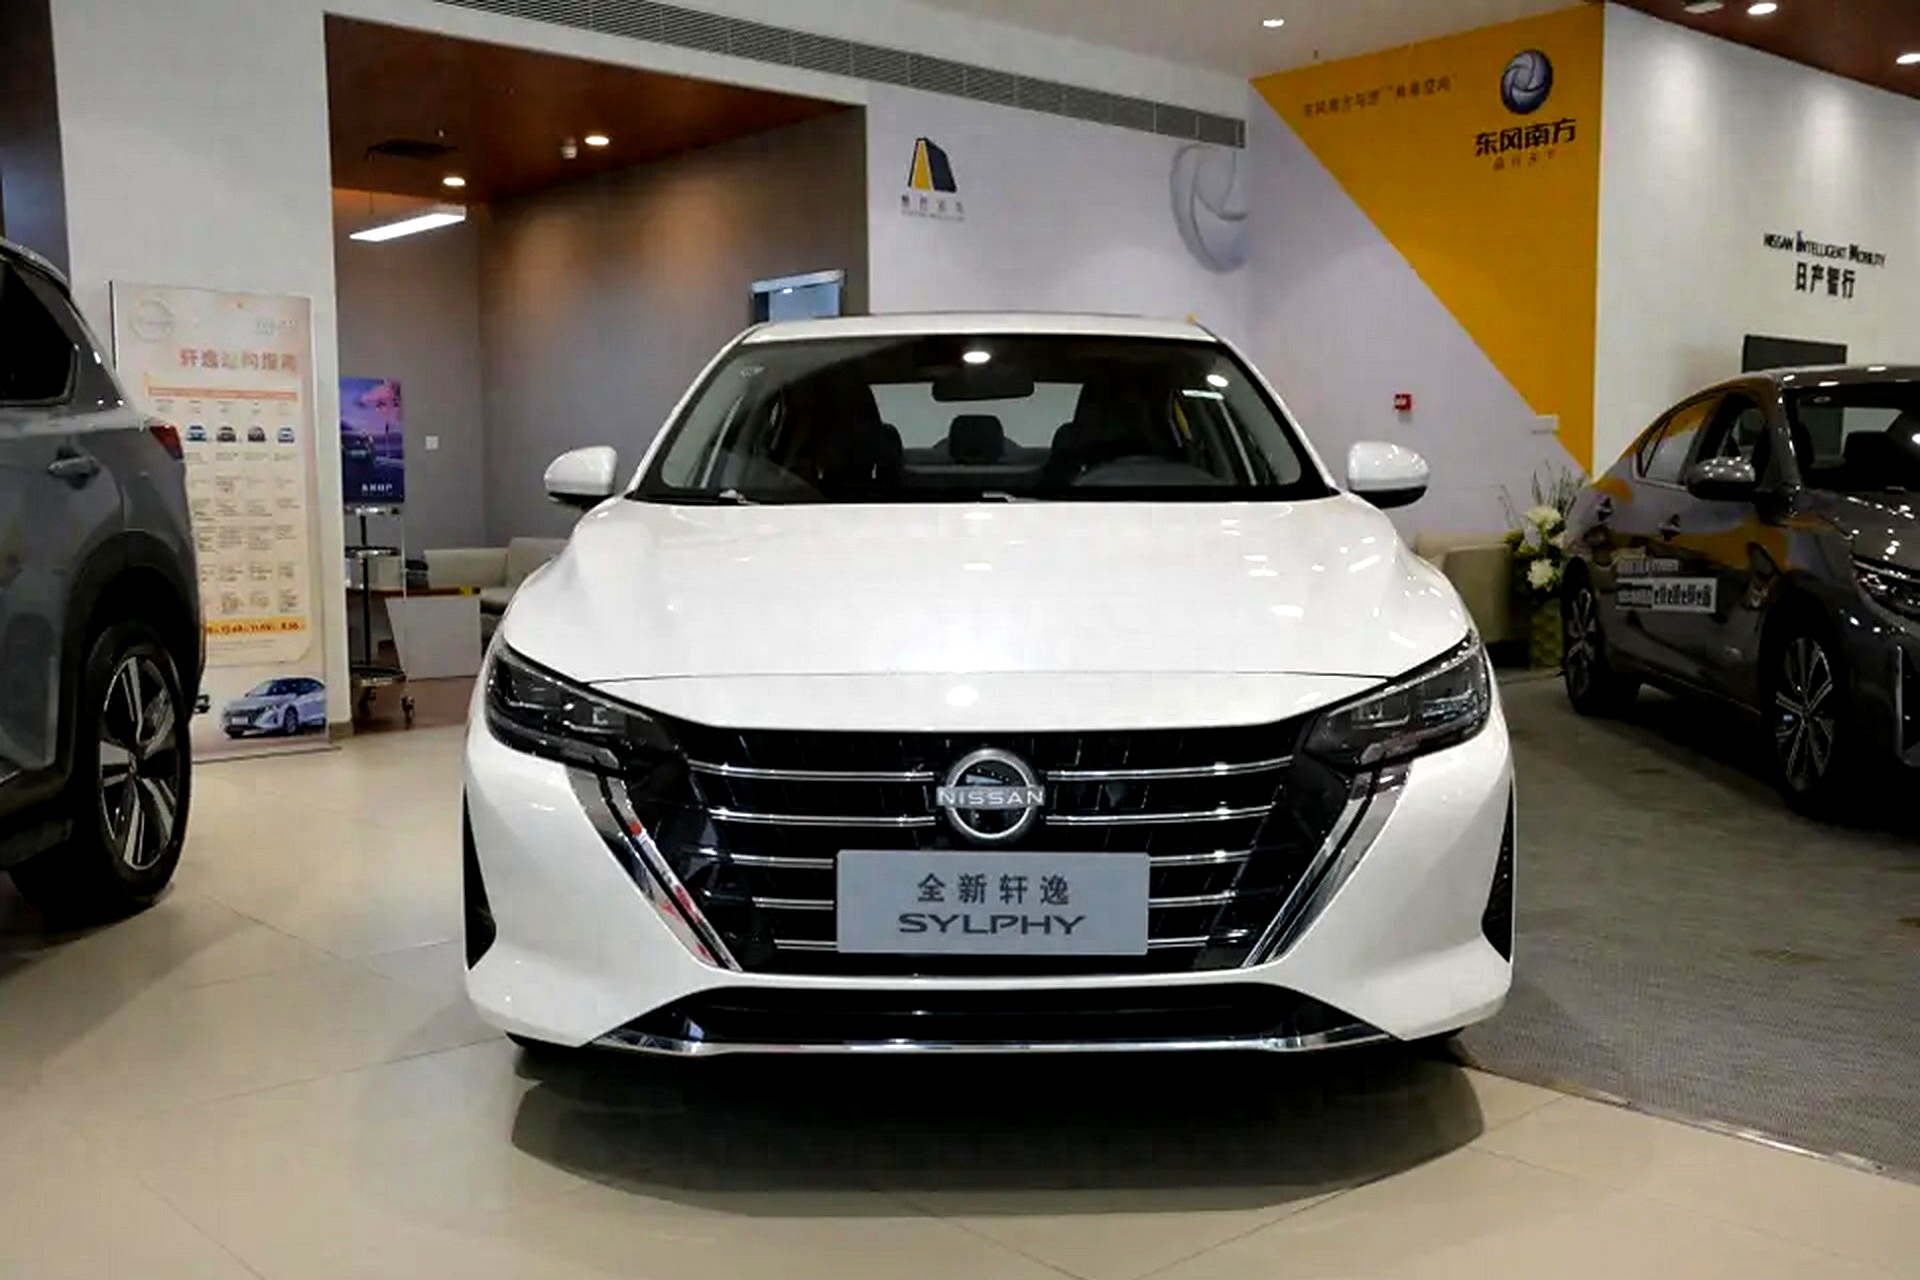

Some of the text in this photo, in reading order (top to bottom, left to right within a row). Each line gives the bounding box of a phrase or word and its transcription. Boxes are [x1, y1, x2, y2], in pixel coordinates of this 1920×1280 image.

[1475, 118, 1576, 157] 东风南方
[1795, 261, 1856, 299] 日产智行
[937, 790, 1044, 805] NISSAN
[917, 872, 1070, 905] 全新轩逸
[898, 913, 1086, 935] SYLPHY
